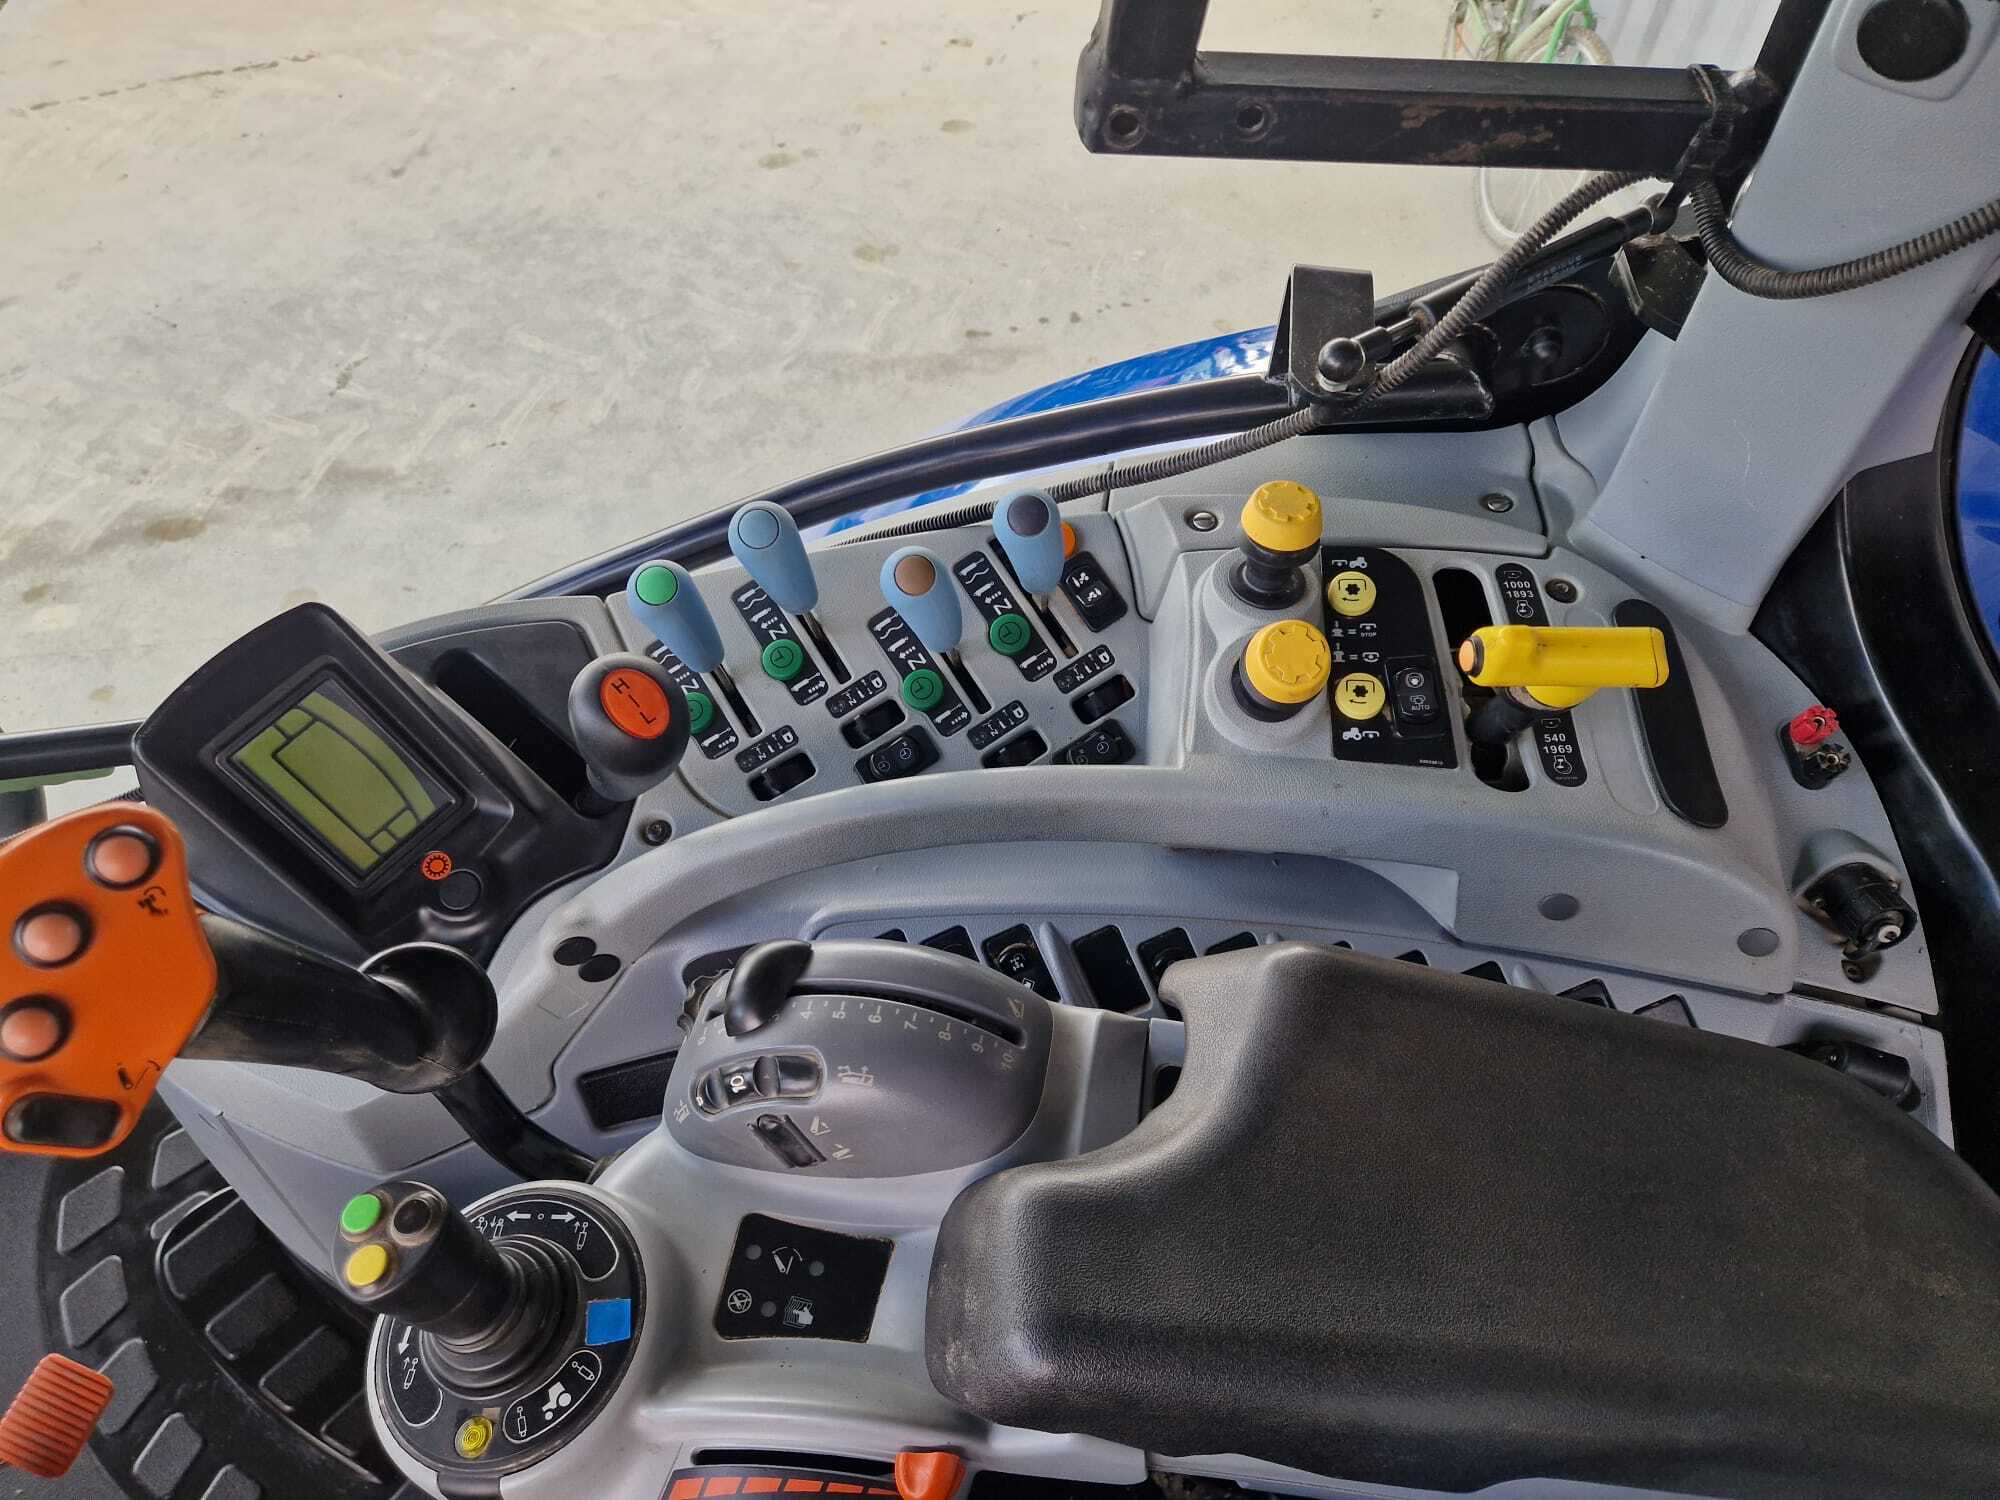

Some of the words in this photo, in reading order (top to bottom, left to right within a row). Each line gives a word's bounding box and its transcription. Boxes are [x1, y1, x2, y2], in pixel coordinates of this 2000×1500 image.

[1503, 581, 1531, 589] 1000
[1506, 590, 1535, 599] 1893
[1543, 733, 1566, 743] 540
[1543, 744, 1573, 754] 1969
[832, 1010, 846, 1020] 5
[867, 1014, 883, 1024] 6
[903, 1020, 918, 1030] 7
[937, 1030, 952, 1041] 8
[730, 1075, 747, 1094] 10
